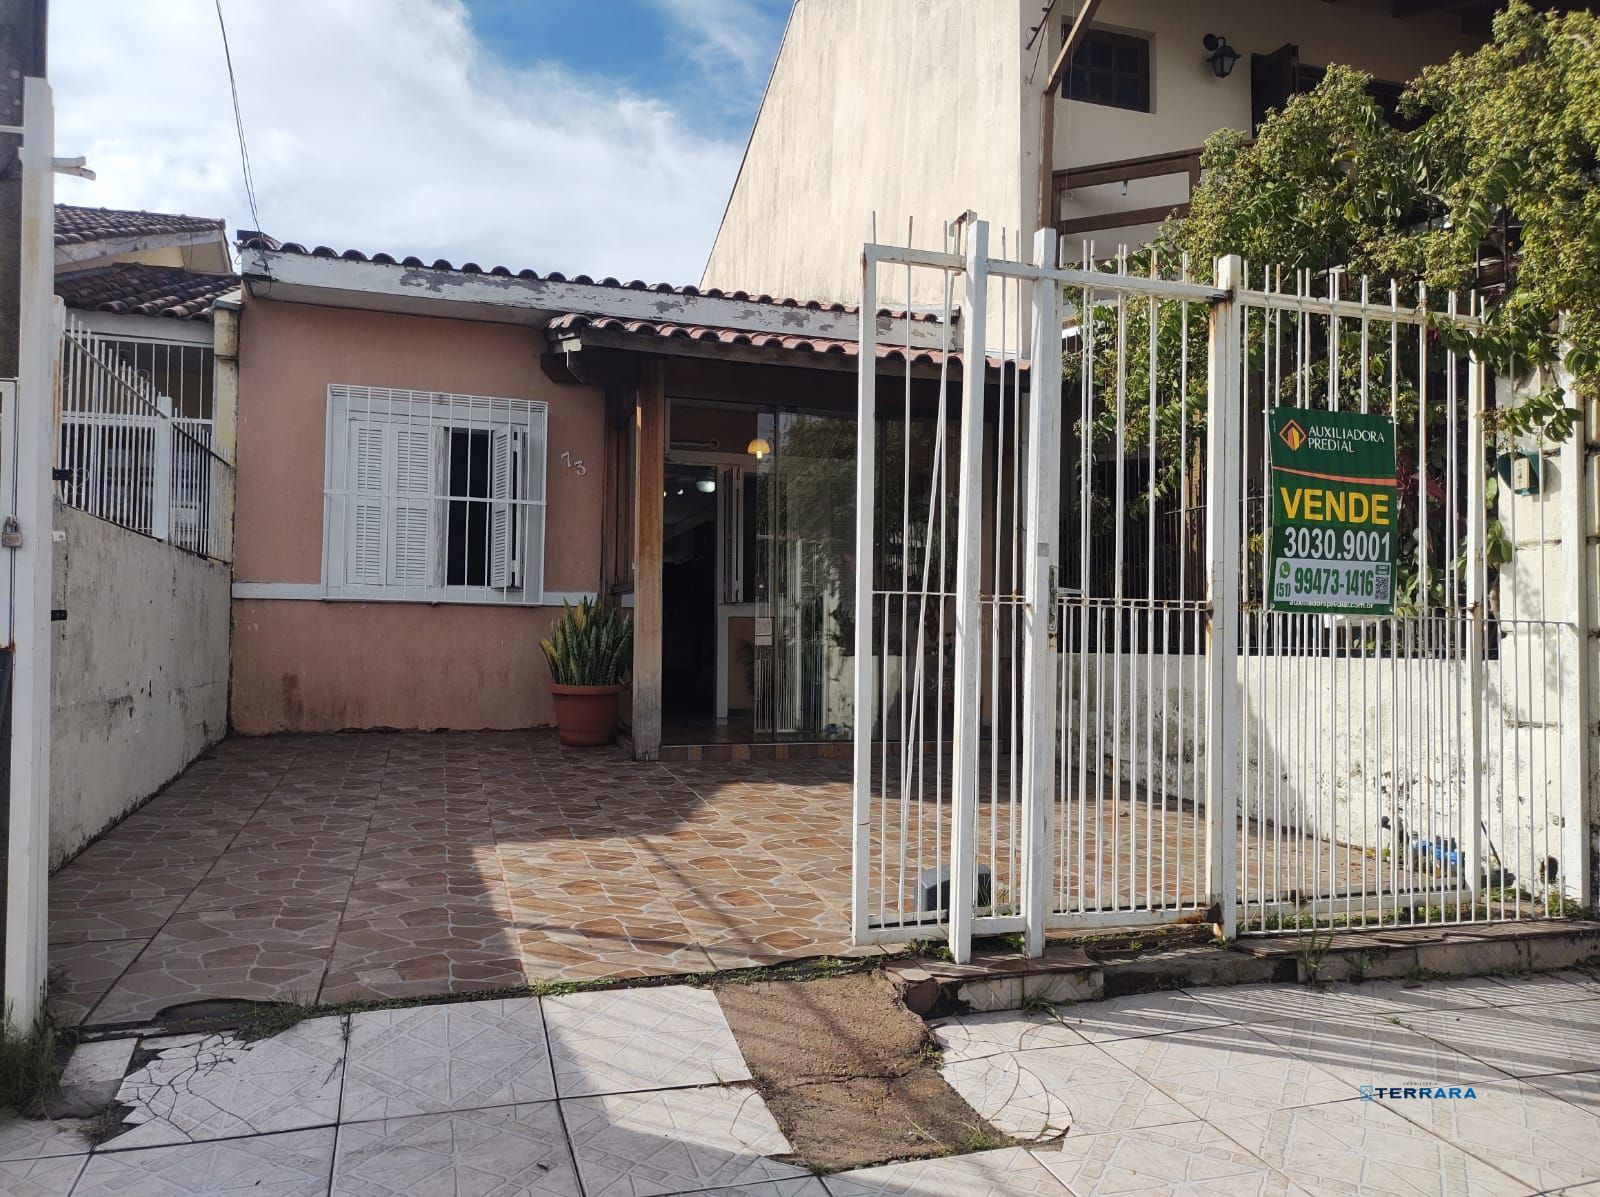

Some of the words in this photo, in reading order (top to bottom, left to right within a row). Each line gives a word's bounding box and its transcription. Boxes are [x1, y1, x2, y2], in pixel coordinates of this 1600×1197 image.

[1308, 425, 1385, 443] AUXILIADORA
[1308, 437, 1355, 453] PREDIAL
[560, 450, 586, 476] 73
[1280, 487, 1390, 525] VENDE
[1283, 527, 1390, 561] 3030.9001
[1276, 582, 1291, 597] (51)
[1294, 567, 1374, 596] 99473-1416
